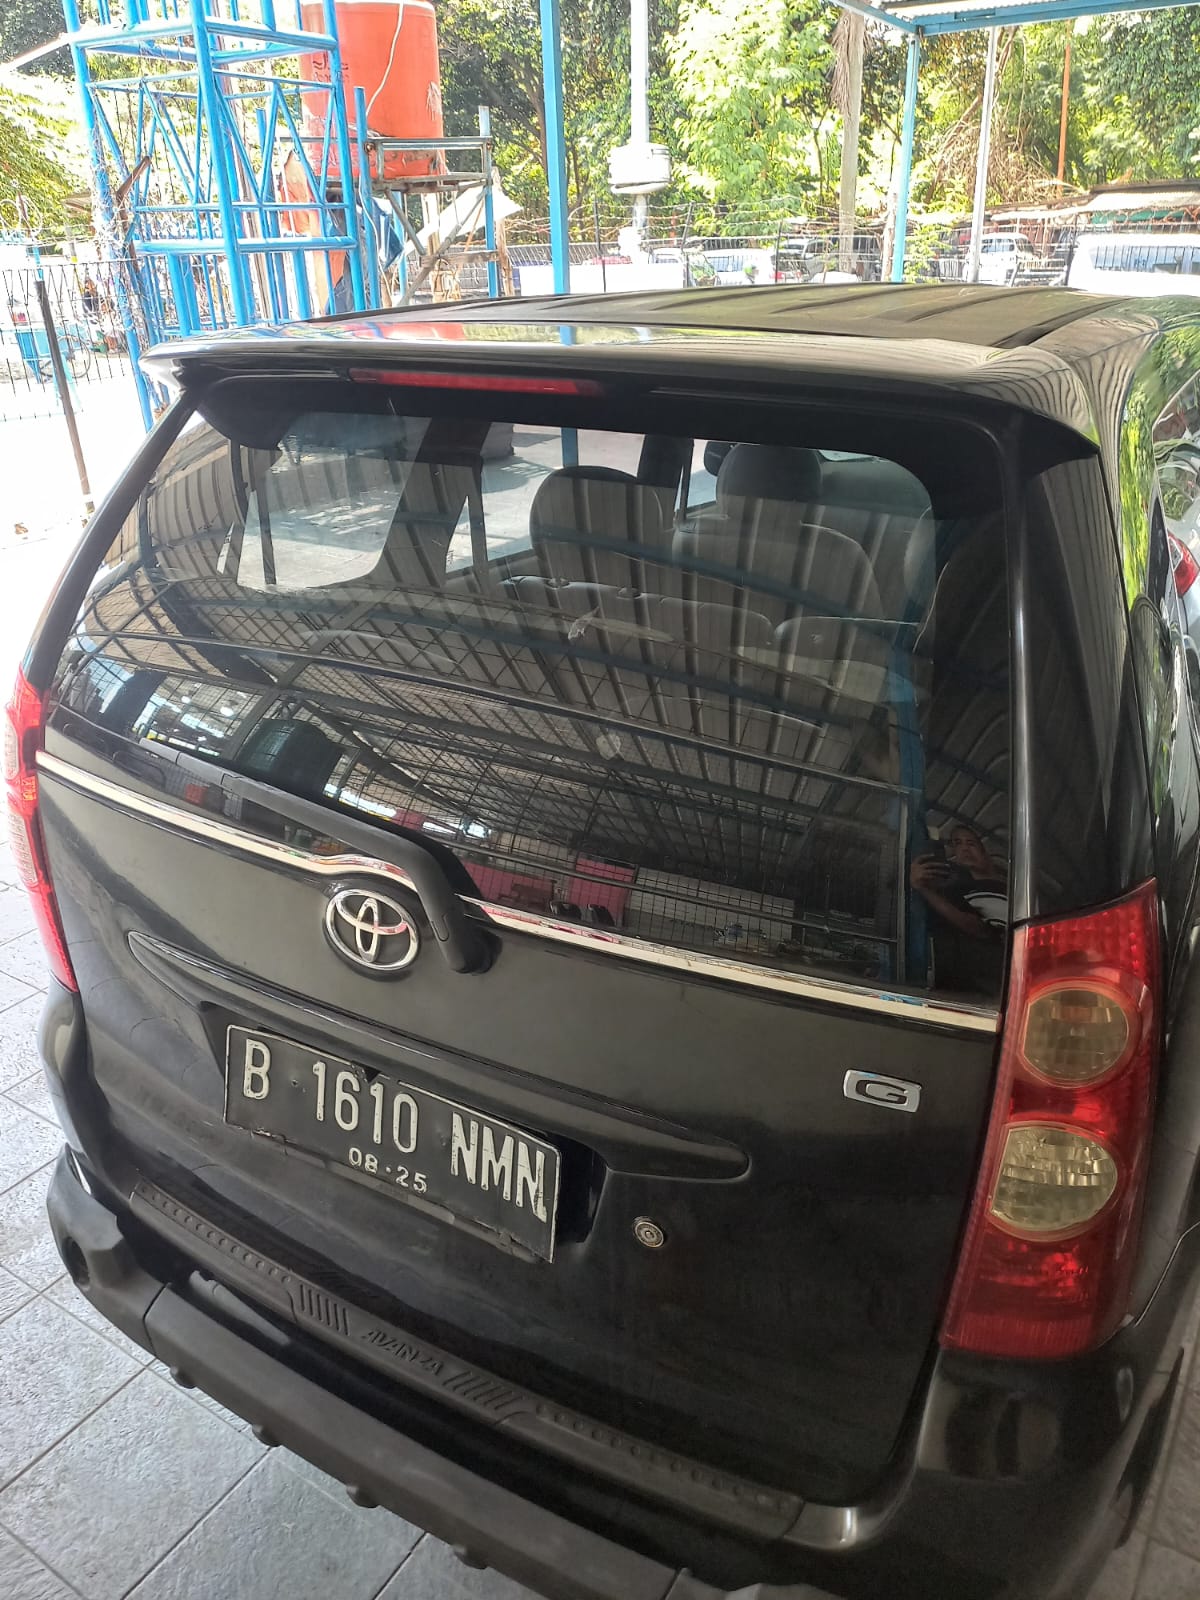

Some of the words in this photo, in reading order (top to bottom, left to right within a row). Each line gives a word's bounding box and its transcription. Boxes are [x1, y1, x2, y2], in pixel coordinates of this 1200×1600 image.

[856, 1079, 909, 1105] G
[243, 1038, 271, 1100] B
[312, 1060, 418, 1153] 1610
[451, 1112, 547, 1223] NMN
[361, 1328, 444, 1377] AVANZA
